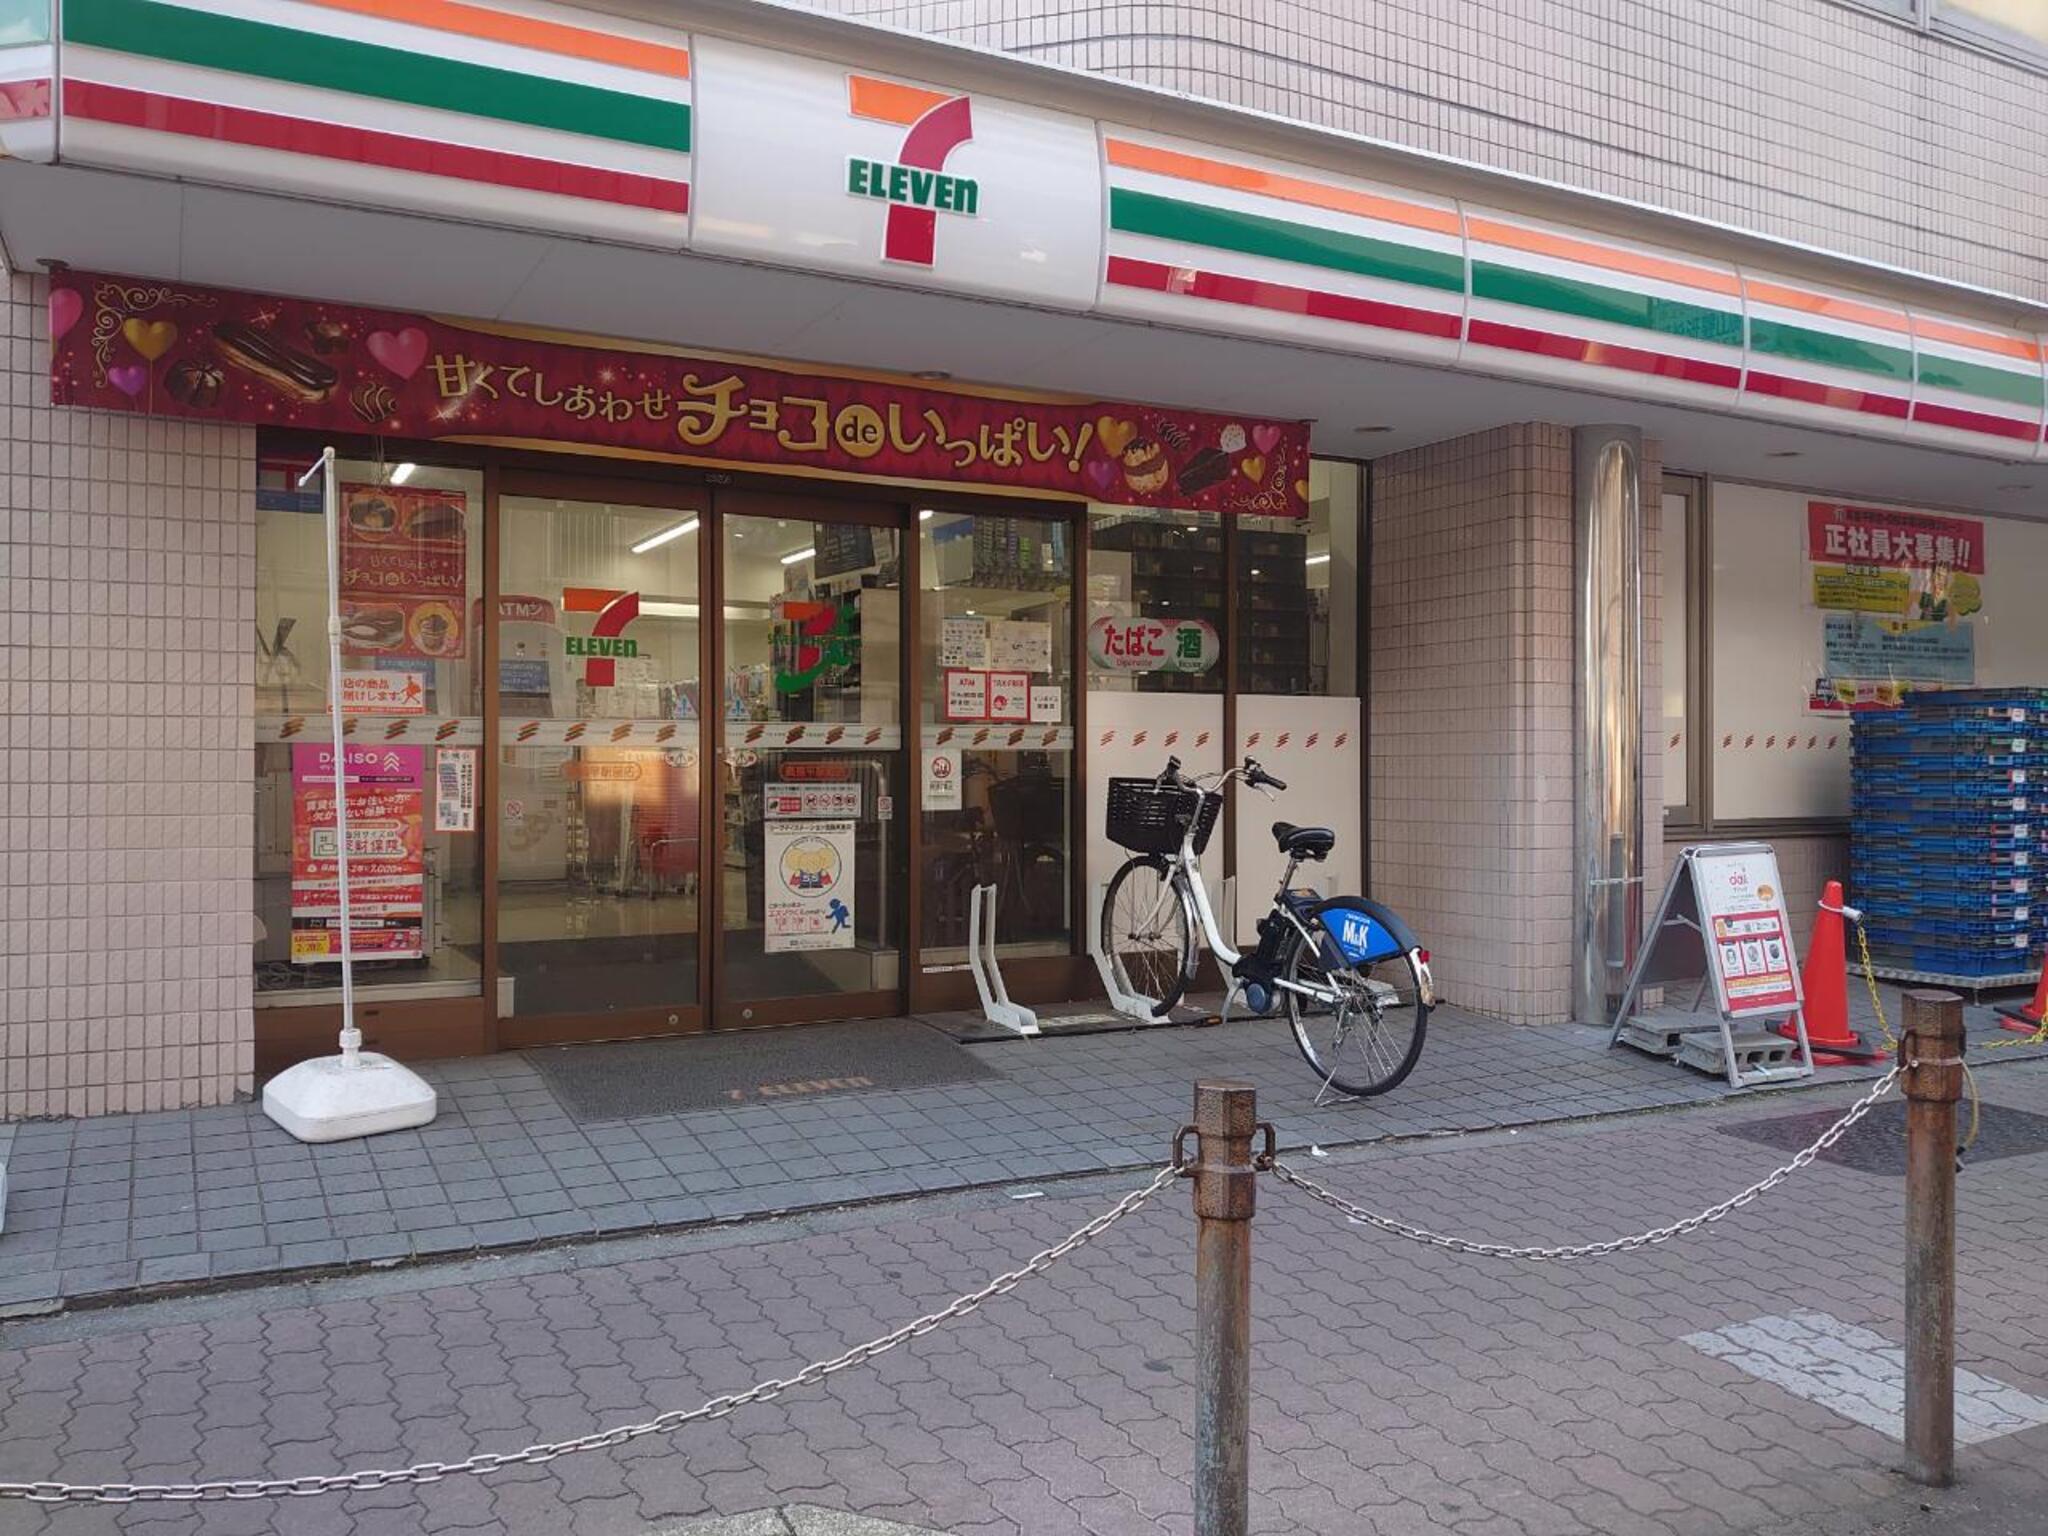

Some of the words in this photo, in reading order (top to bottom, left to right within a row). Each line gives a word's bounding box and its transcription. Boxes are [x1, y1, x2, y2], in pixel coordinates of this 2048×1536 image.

[426, 354, 671, 423] 甘くてしあわせ
[1825, 524, 1971, 568] 正社員大募集!!
[1104, 624, 1165, 657] たばこ
[1176, 628, 1203, 658] 酒
